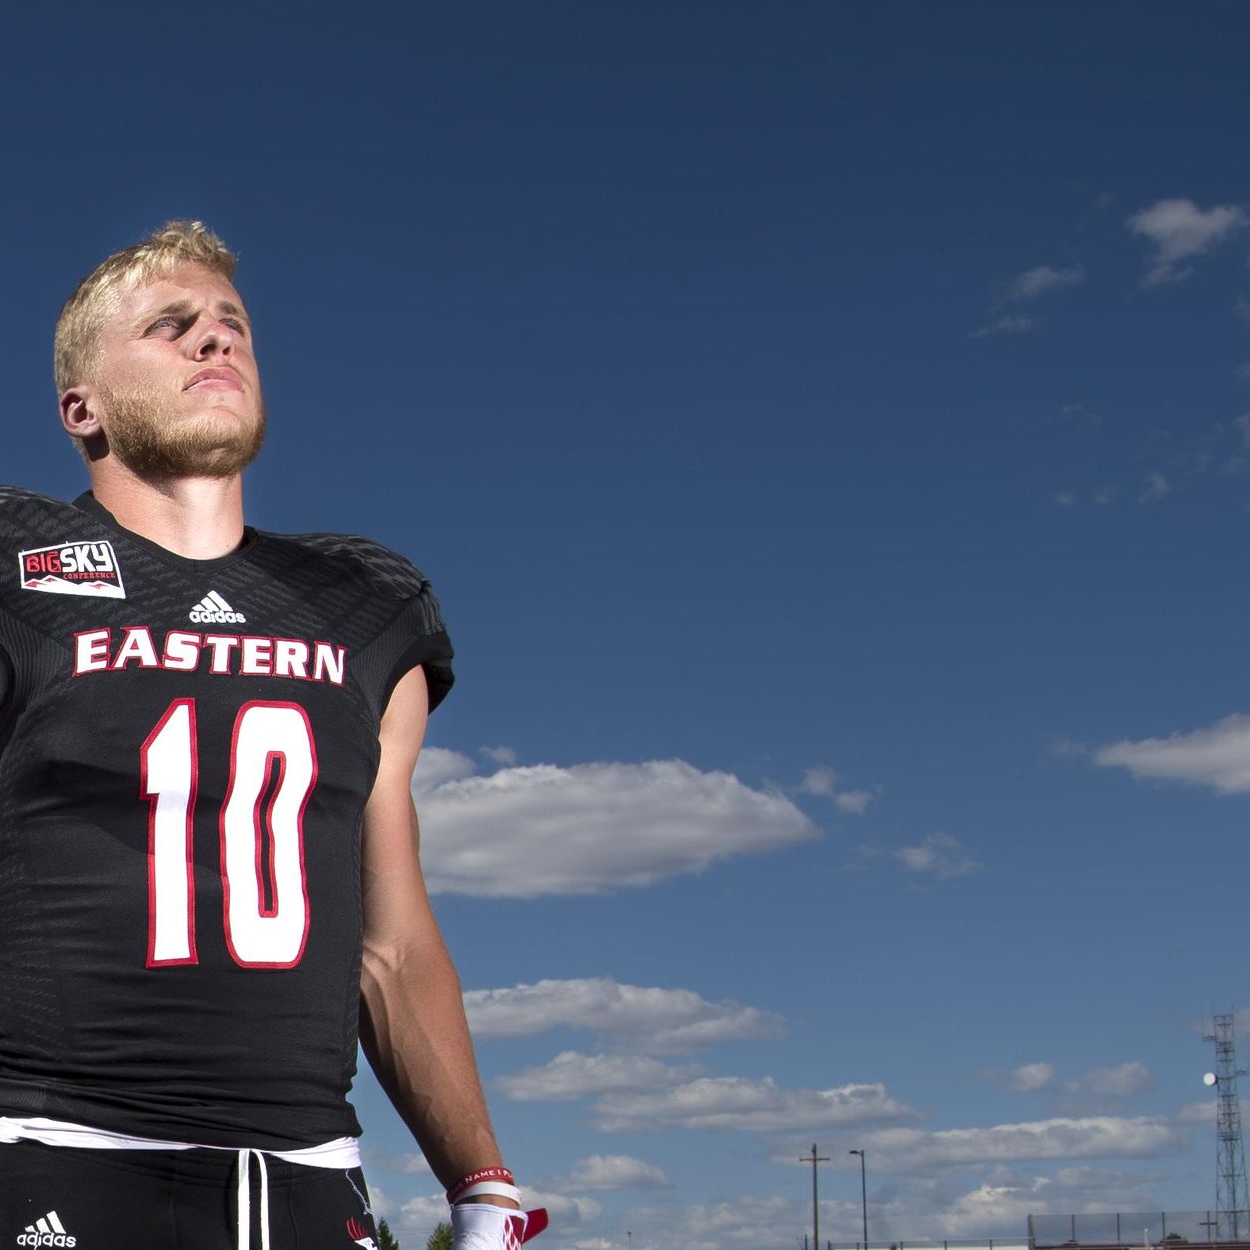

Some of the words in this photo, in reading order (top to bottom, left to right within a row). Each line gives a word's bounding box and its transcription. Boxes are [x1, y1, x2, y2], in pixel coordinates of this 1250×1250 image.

[26, 550, 62, 573] BIG
[60, 544, 114, 573] SKY
[63, 572, 116, 580] CONFERENCE
[189, 609, 246, 624] adidas
[72, 625, 348, 687] EASTERN
[139, 697, 318, 970] 10
[465, 1170, 495, 1184] NAME
[16, 1231, 77, 1248] adidas
